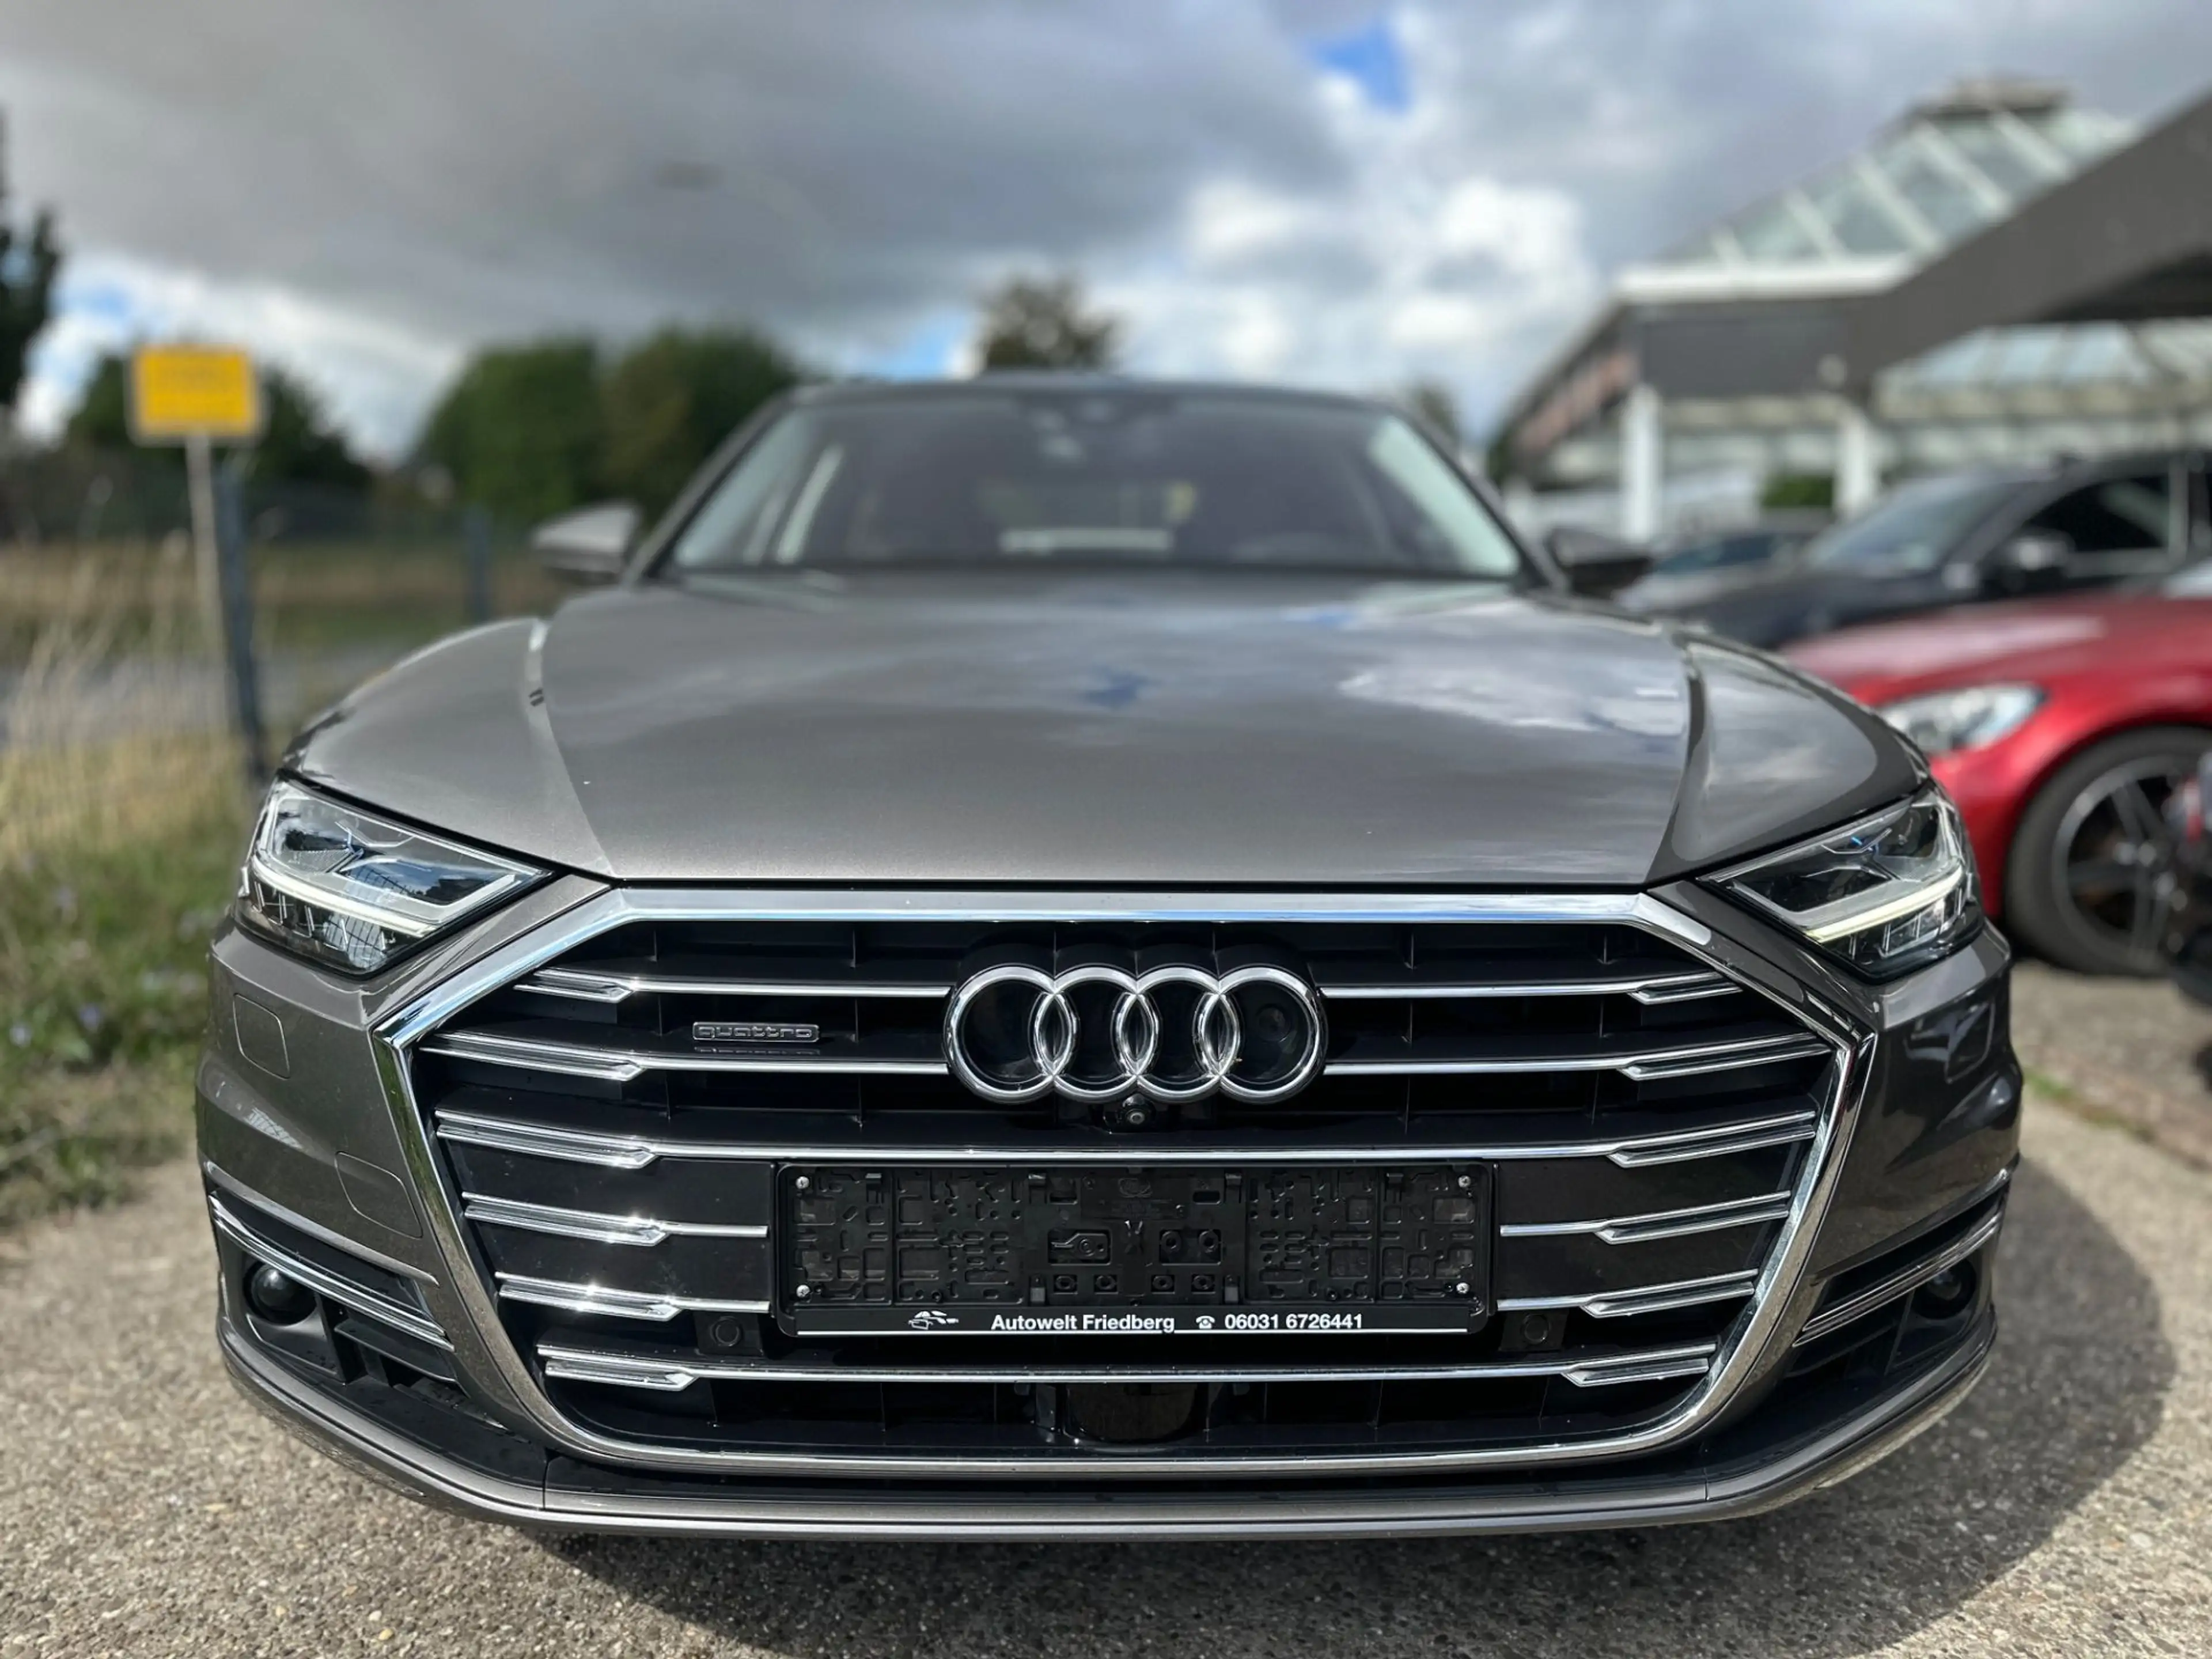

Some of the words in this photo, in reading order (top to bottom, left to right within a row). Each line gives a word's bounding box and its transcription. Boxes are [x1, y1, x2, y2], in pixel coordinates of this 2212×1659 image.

[698, 1025, 813, 1039] quattro
[990, 1314, 1078, 1330] Autowelt
[1082, 1314, 1175, 1334] Friedberg
[1224, 1313, 1279, 1330] 06031
[1285, 1313, 1362, 1330] 6726441
